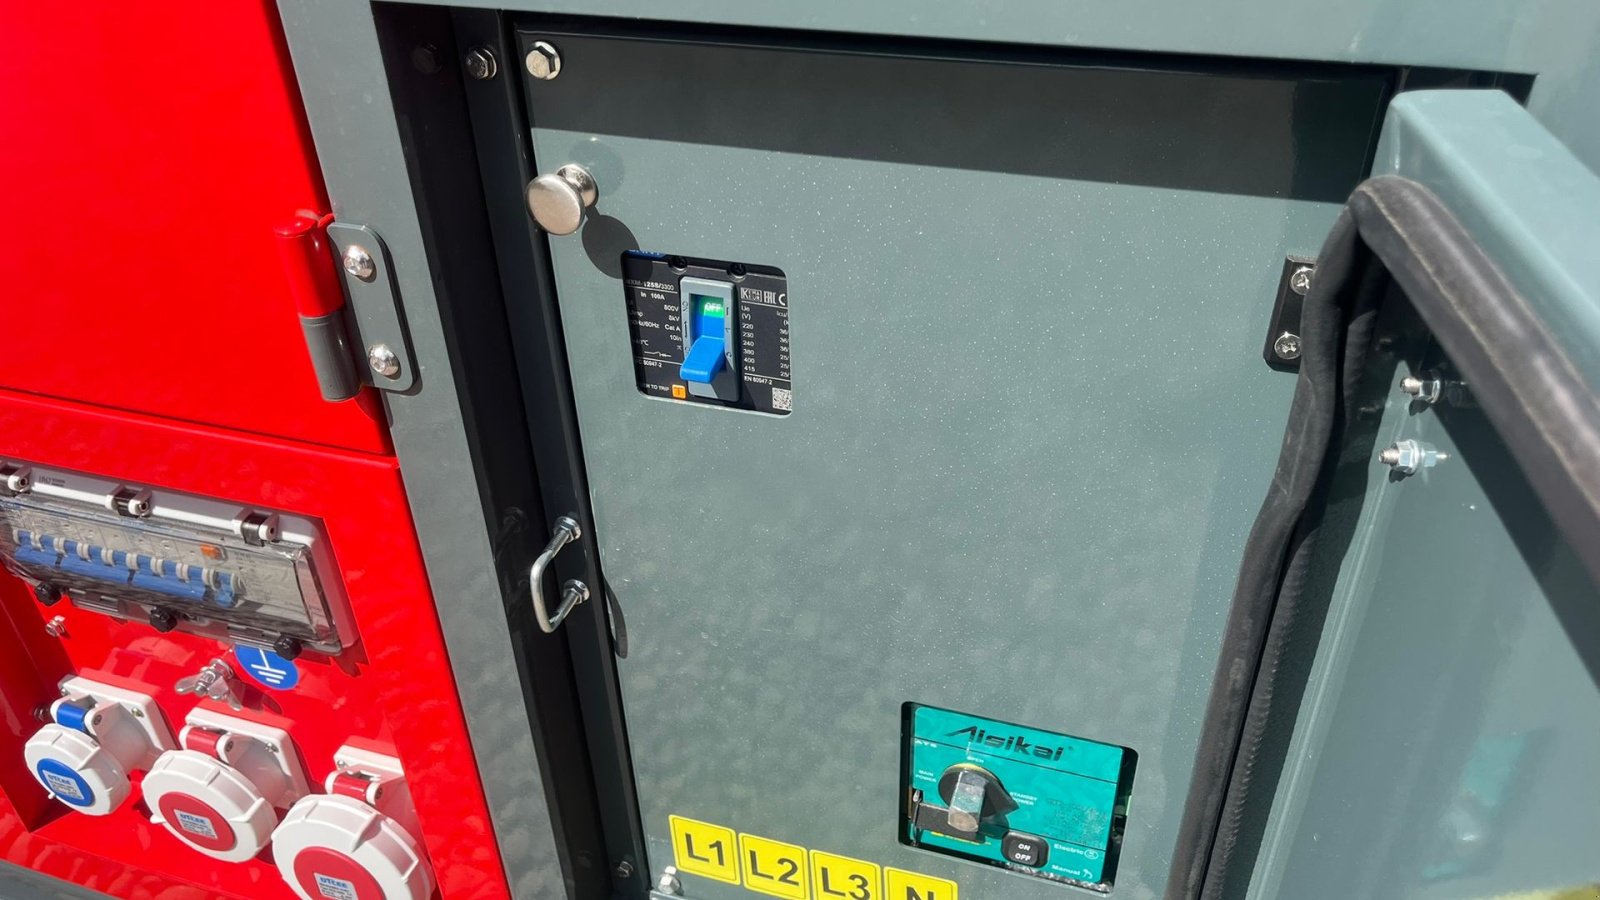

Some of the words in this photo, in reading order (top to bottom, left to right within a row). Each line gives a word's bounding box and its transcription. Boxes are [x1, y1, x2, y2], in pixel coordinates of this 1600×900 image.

[650, 292, 665, 301] 100A
[704, 302, 722, 312] OFF
[741, 313, 751, 321] (V)
[753, 377, 773, 385] 60947-2
[944, 726, 1064, 761] Aisikai
[685, 833, 725, 866] L1
[1018, 843, 1031, 851] ON
[1053, 843, 1084, 855] Electric
[1015, 852, 1031, 861] OFF
[749, 850, 799, 886] L2
[1052, 864, 1081, 876] Manual
[821, 867, 871, 900] L3
[906, 886, 935, 900] N
